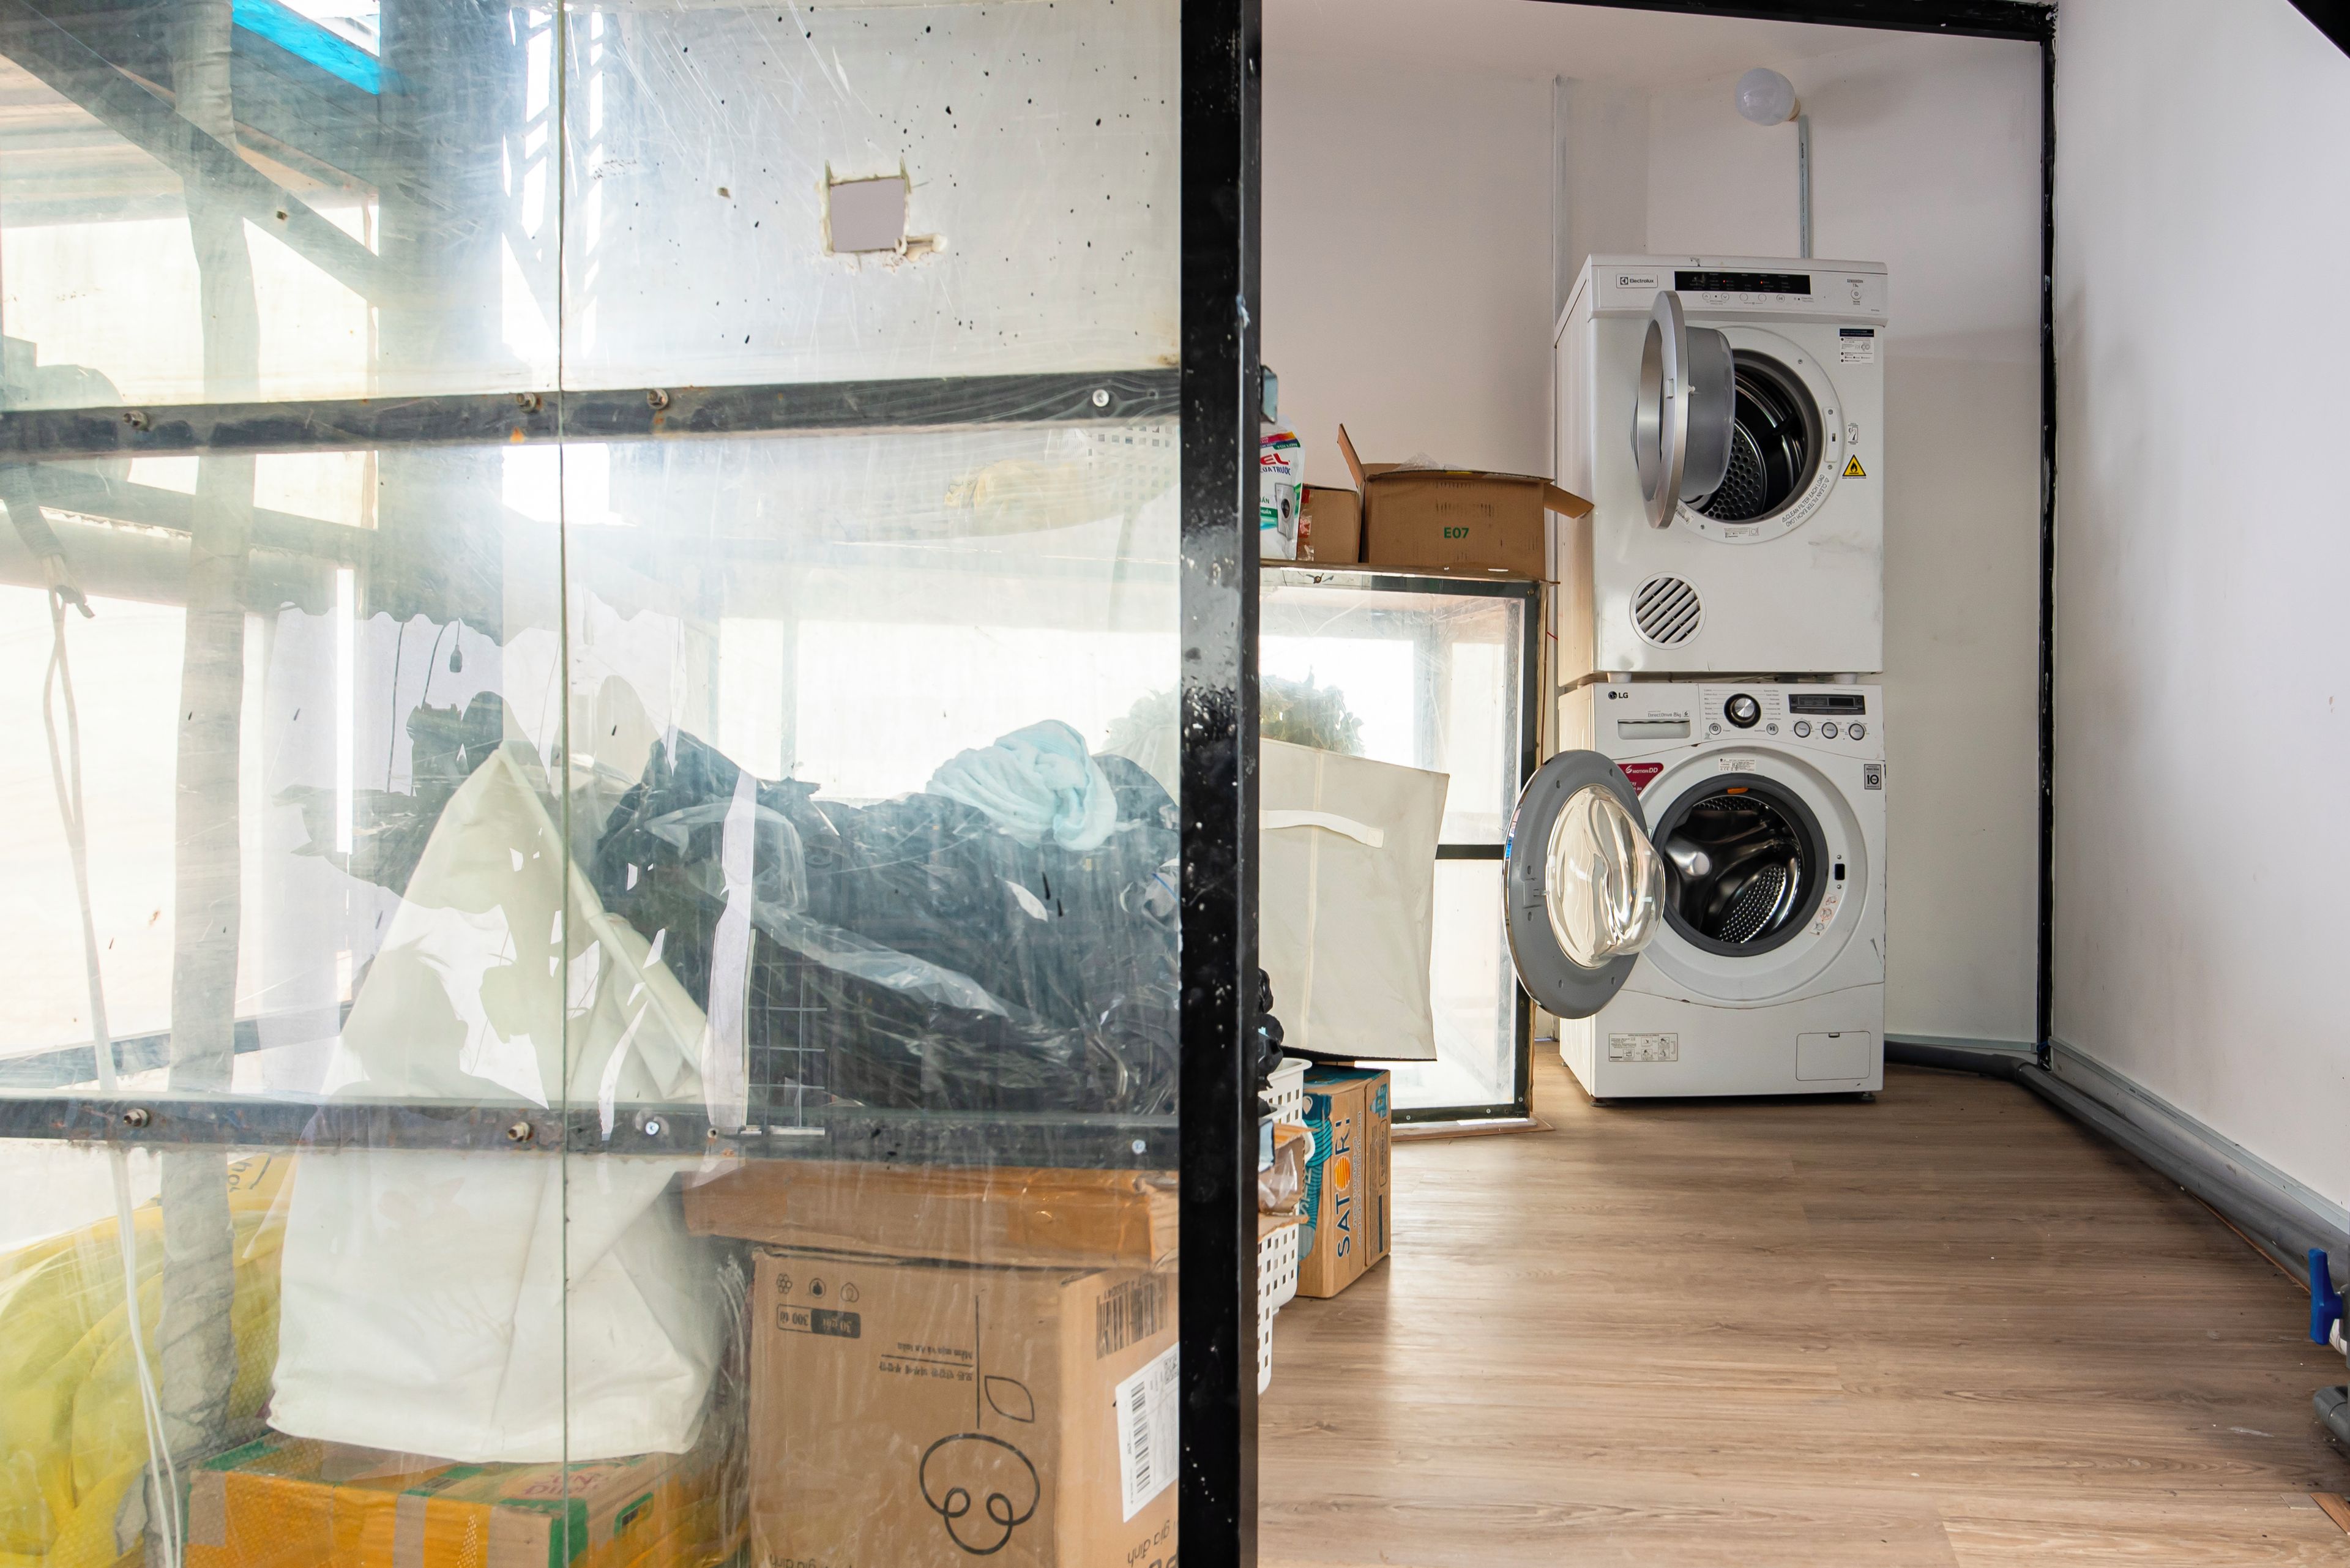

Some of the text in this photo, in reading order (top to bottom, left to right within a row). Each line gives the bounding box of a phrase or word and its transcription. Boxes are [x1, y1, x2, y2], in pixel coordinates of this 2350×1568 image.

[1785, 474, 1825, 520] CLEAN FILTER EACH LOAD
[1786, 483, 1827, 527] CLEAN FILTER EACH LOAD
[1444, 526, 1469, 539] E07
[1867, 774, 1879, 785] 10
[793, 1313, 809, 1326] 300
